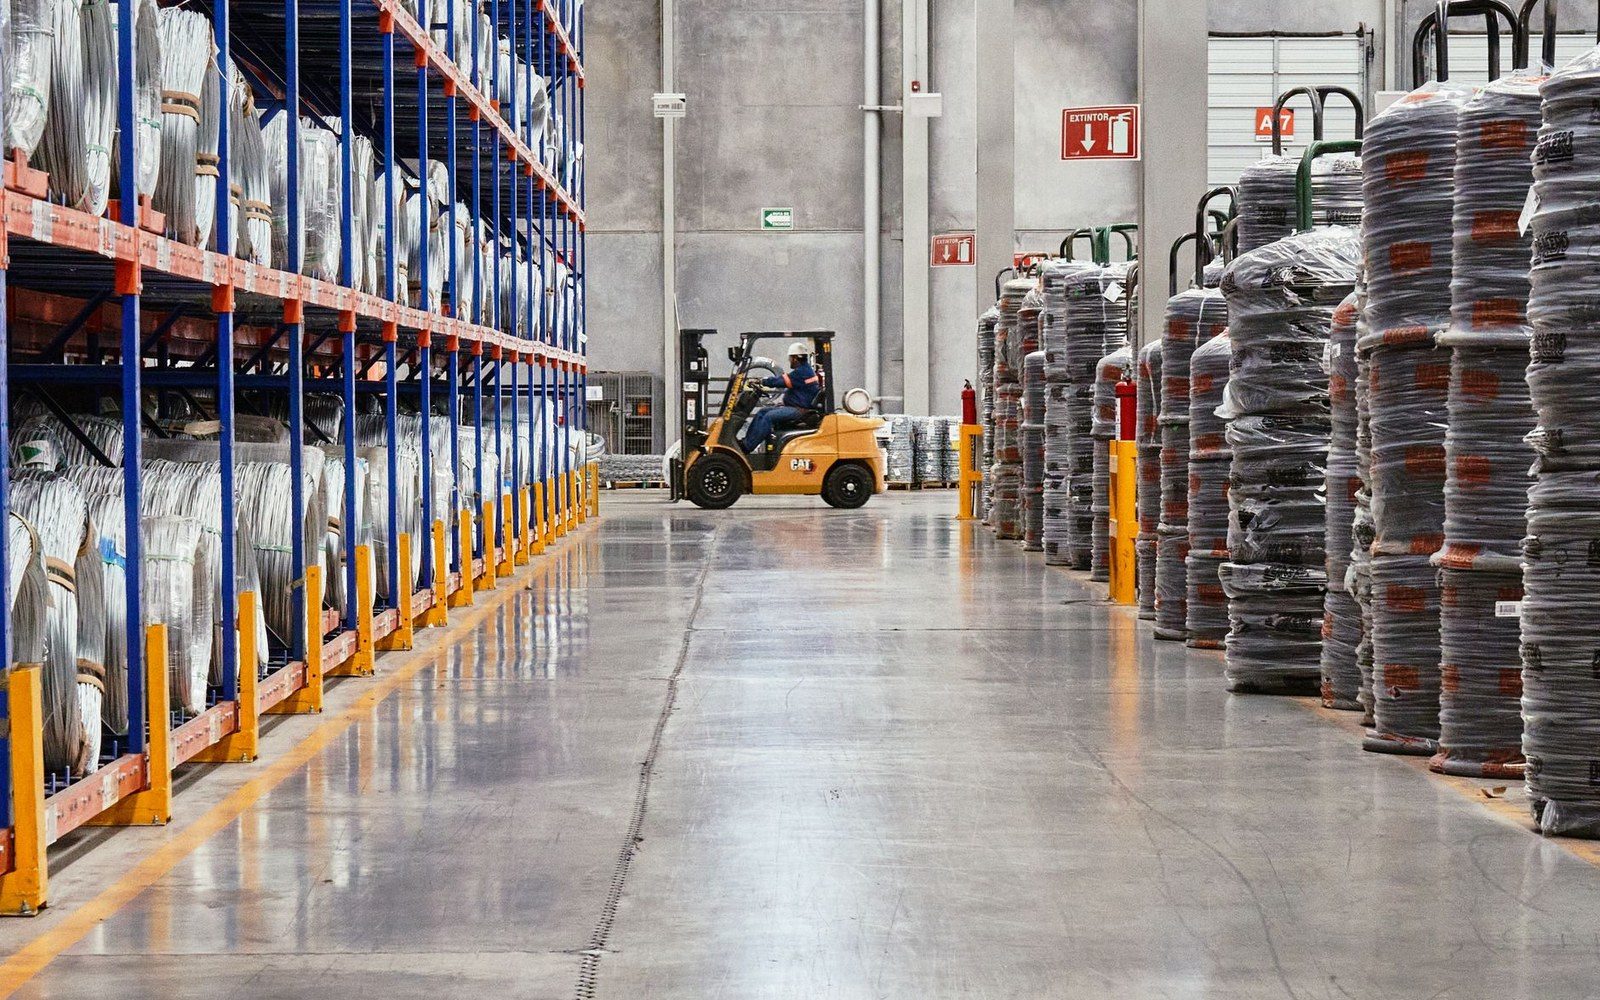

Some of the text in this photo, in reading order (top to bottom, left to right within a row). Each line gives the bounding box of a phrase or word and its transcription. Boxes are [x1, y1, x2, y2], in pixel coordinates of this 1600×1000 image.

[1069, 112, 1109, 123] EXTINTOR
[1260, 114, 1291, 131] A7
[791, 458, 811, 471] CAT
